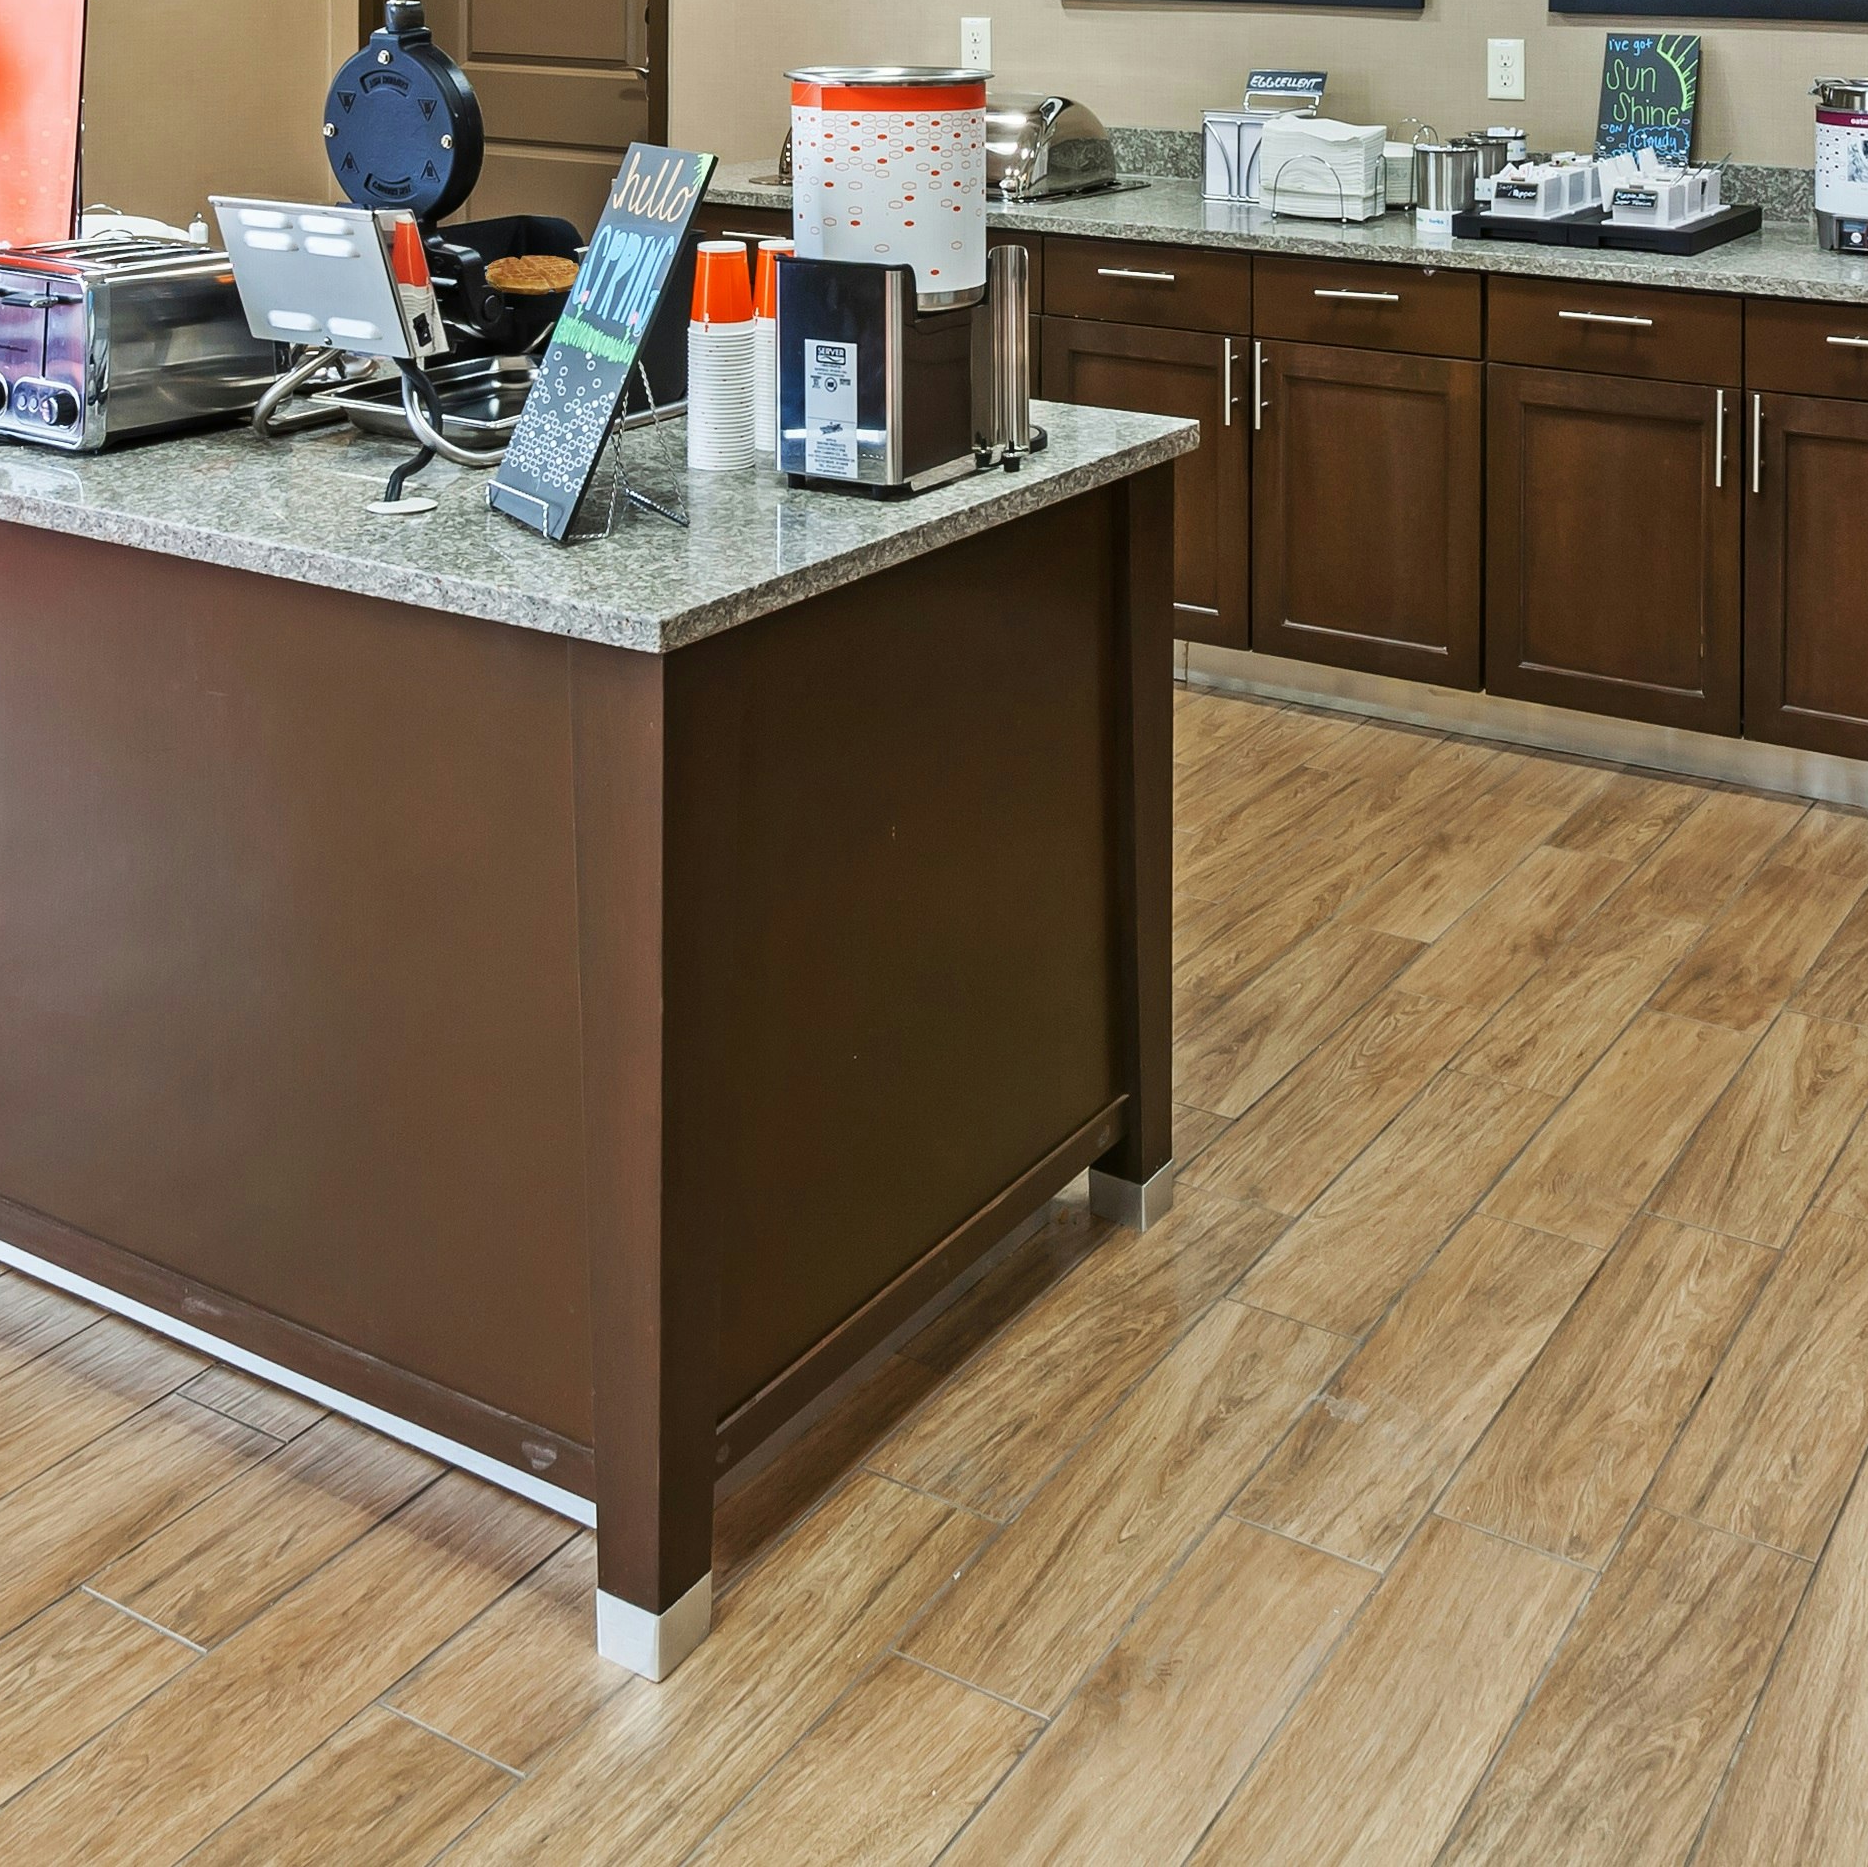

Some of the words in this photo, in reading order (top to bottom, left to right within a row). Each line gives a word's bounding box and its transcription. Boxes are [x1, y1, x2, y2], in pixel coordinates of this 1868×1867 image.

[1633, 38, 1653, 56] got
[1250, 75, 1323, 89] EGGCELLENT
[1613, 92, 1681, 127] Shine
[612, 151, 695, 223] hello
